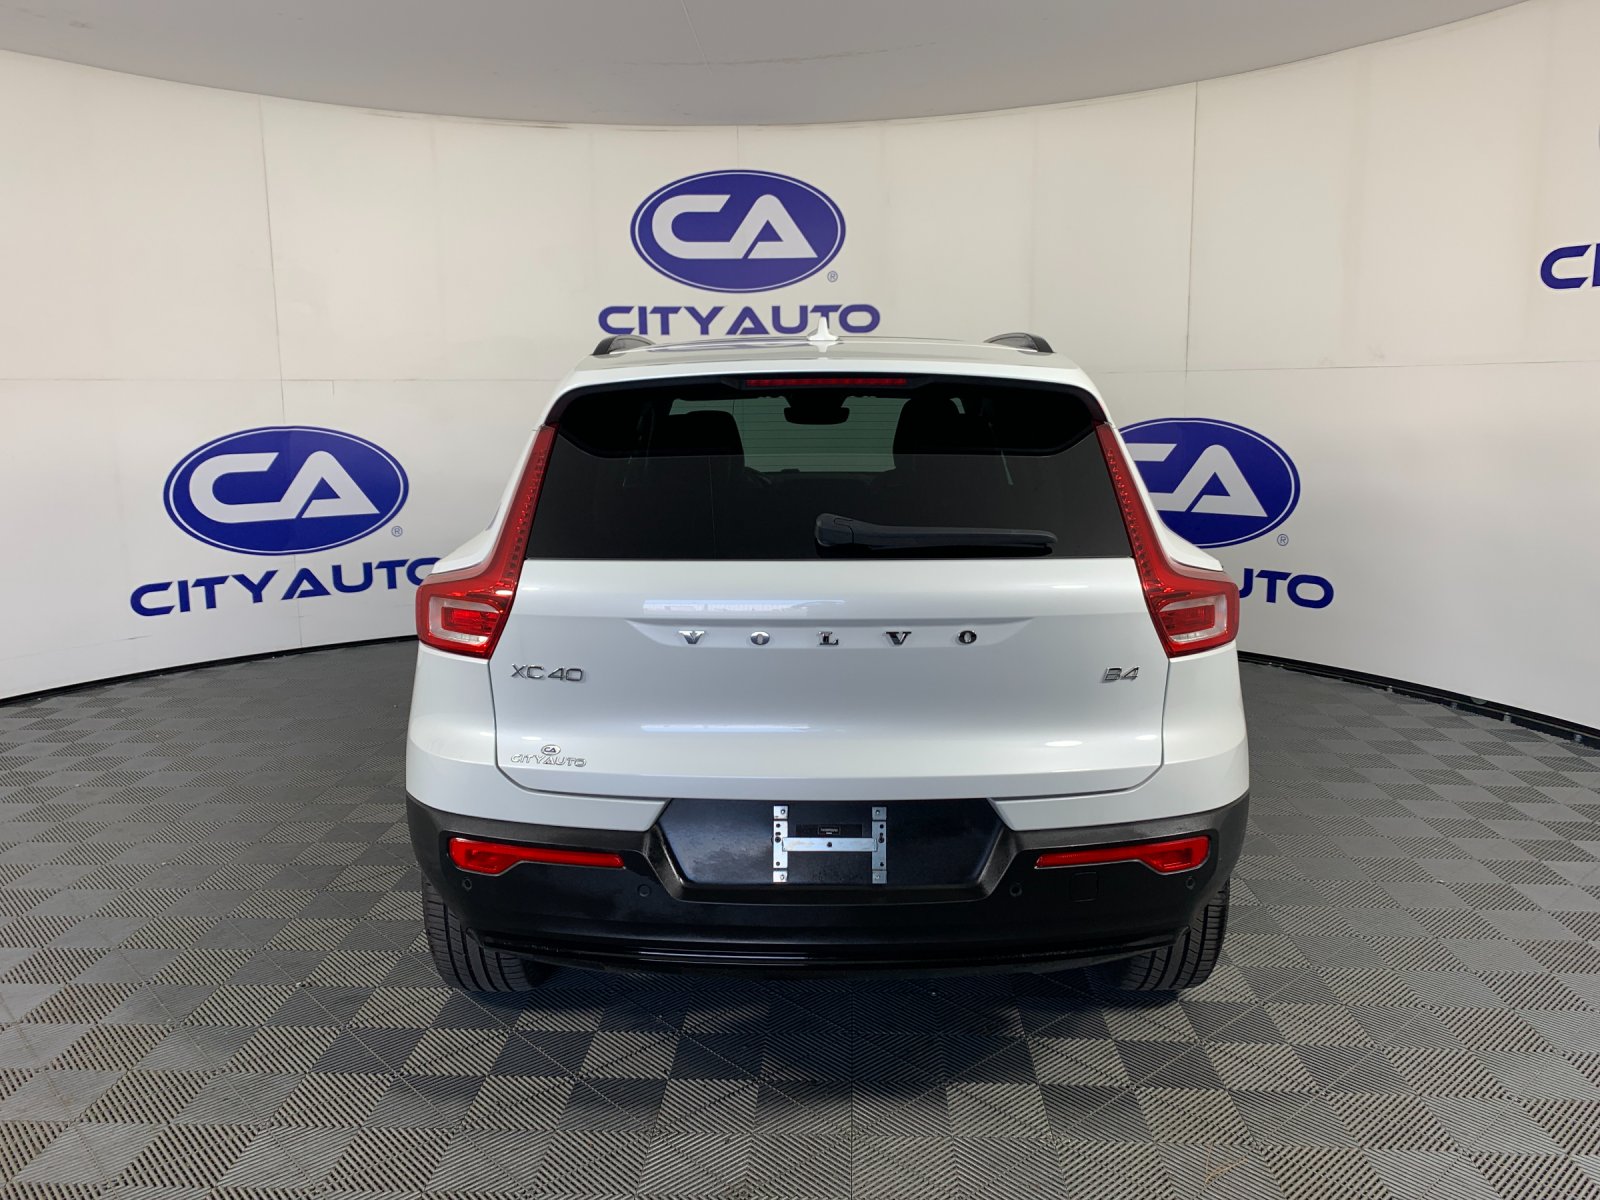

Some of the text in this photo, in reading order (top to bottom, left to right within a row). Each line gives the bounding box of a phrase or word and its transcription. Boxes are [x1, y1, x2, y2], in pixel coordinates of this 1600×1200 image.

[652, 194, 818, 259] CA
[189, 450, 380, 523] CA
[678, 630, 977, 646] VOLVO
[1104, 666, 1139, 682] B4
